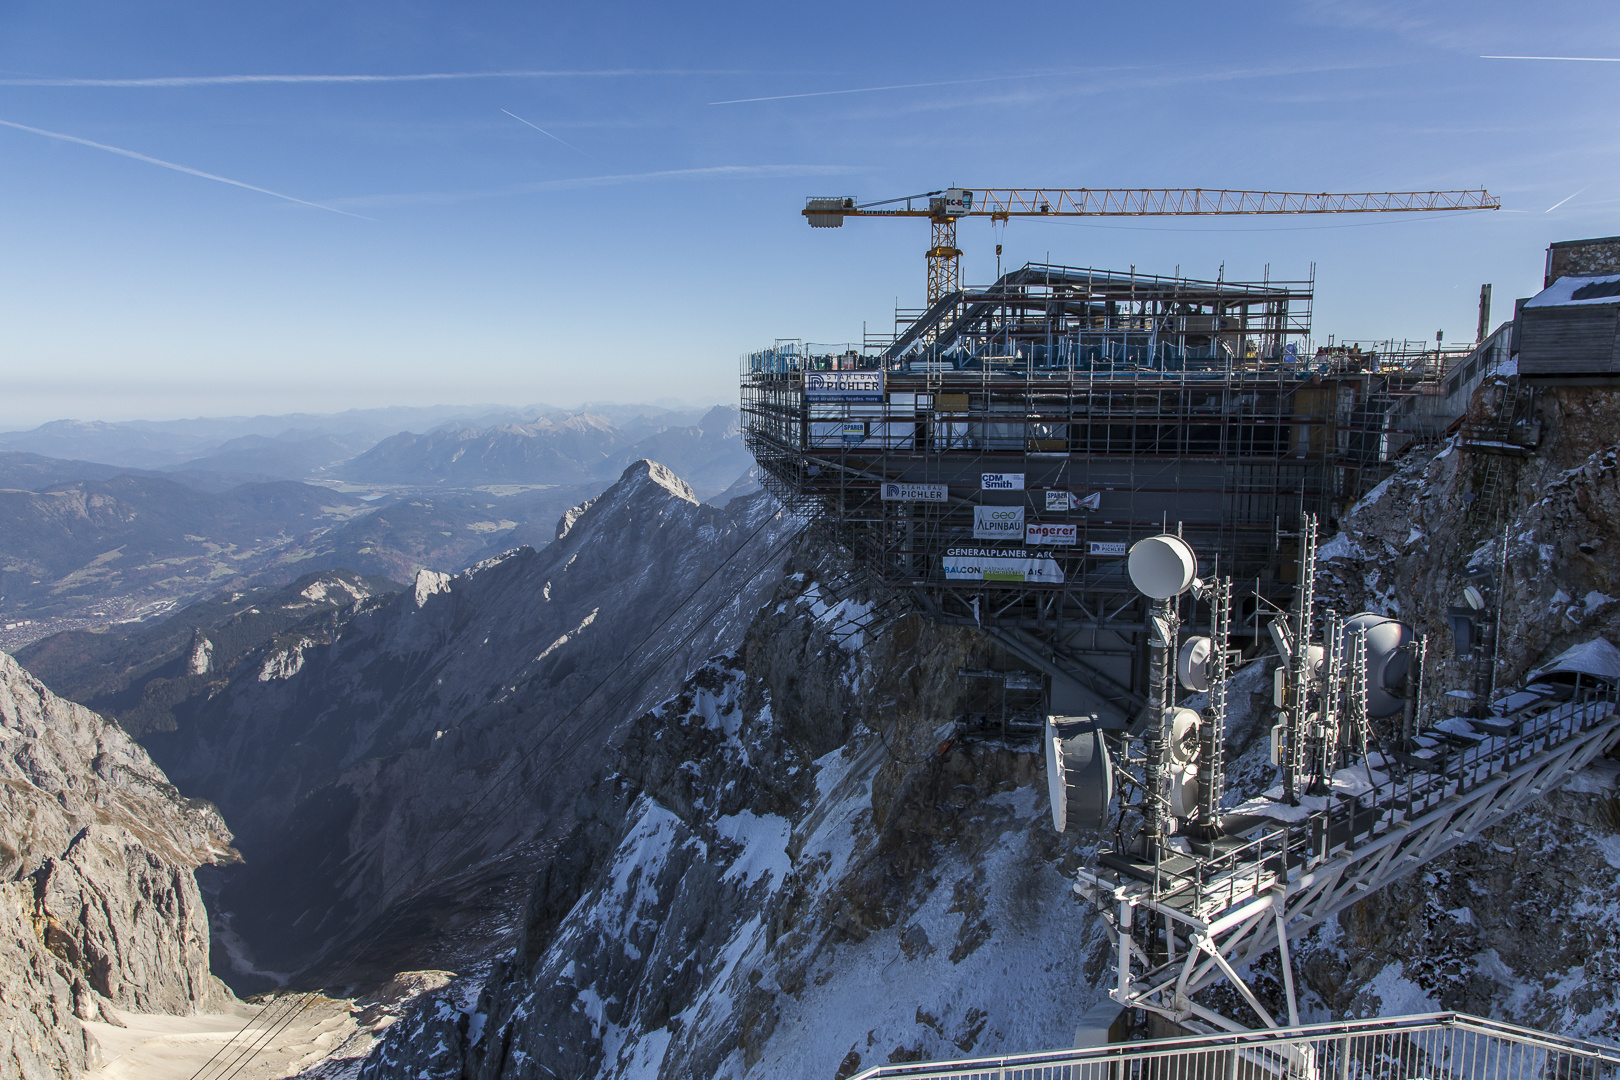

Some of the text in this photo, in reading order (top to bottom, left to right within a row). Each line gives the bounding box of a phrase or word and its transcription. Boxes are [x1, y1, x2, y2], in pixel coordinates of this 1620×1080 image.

[826, 382, 880, 391] PICHLER
[902, 490, 942, 498] PICHLER
[977, 518, 1021, 531] ALPINBAU
[1028, 527, 1075, 537] angerer
[946, 548, 1027, 558] GENERALPLANER
